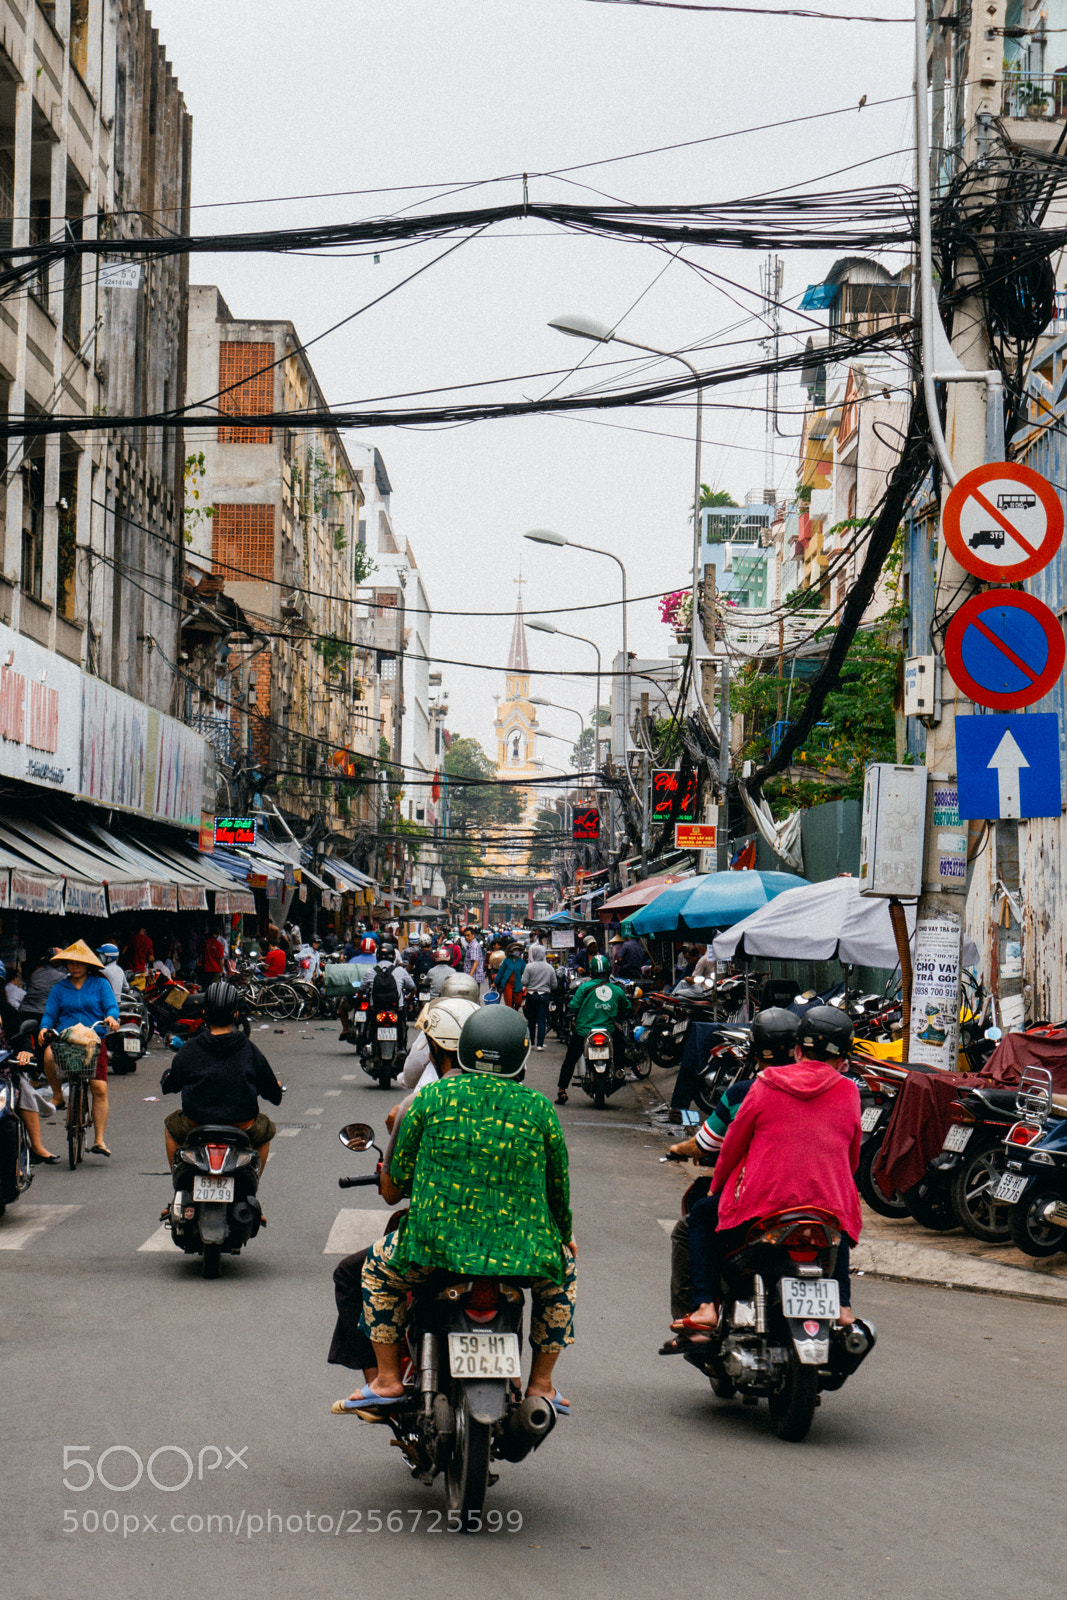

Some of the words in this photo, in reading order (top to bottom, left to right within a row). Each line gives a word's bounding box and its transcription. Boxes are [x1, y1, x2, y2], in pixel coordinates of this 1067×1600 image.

[989, 531, 1004, 539] 3T5
[916, 962, 935, 972] CHO
[938, 963, 958, 974] VAY
[938, 973, 957, 983] GÓP
[930, 987, 944, 997] 700
[594, 1002, 611, 1011] Grab
[200, 1177, 228, 1189] 63-B2
[195, 1189, 231, 1200] 207.99
[791, 1281, 829, 1299] 59-H1
[787, 1299, 835, 1316] 172.54
[460, 1336, 505, 1354] 59-H1
[455, 1355, 515, 1374] 204.43
